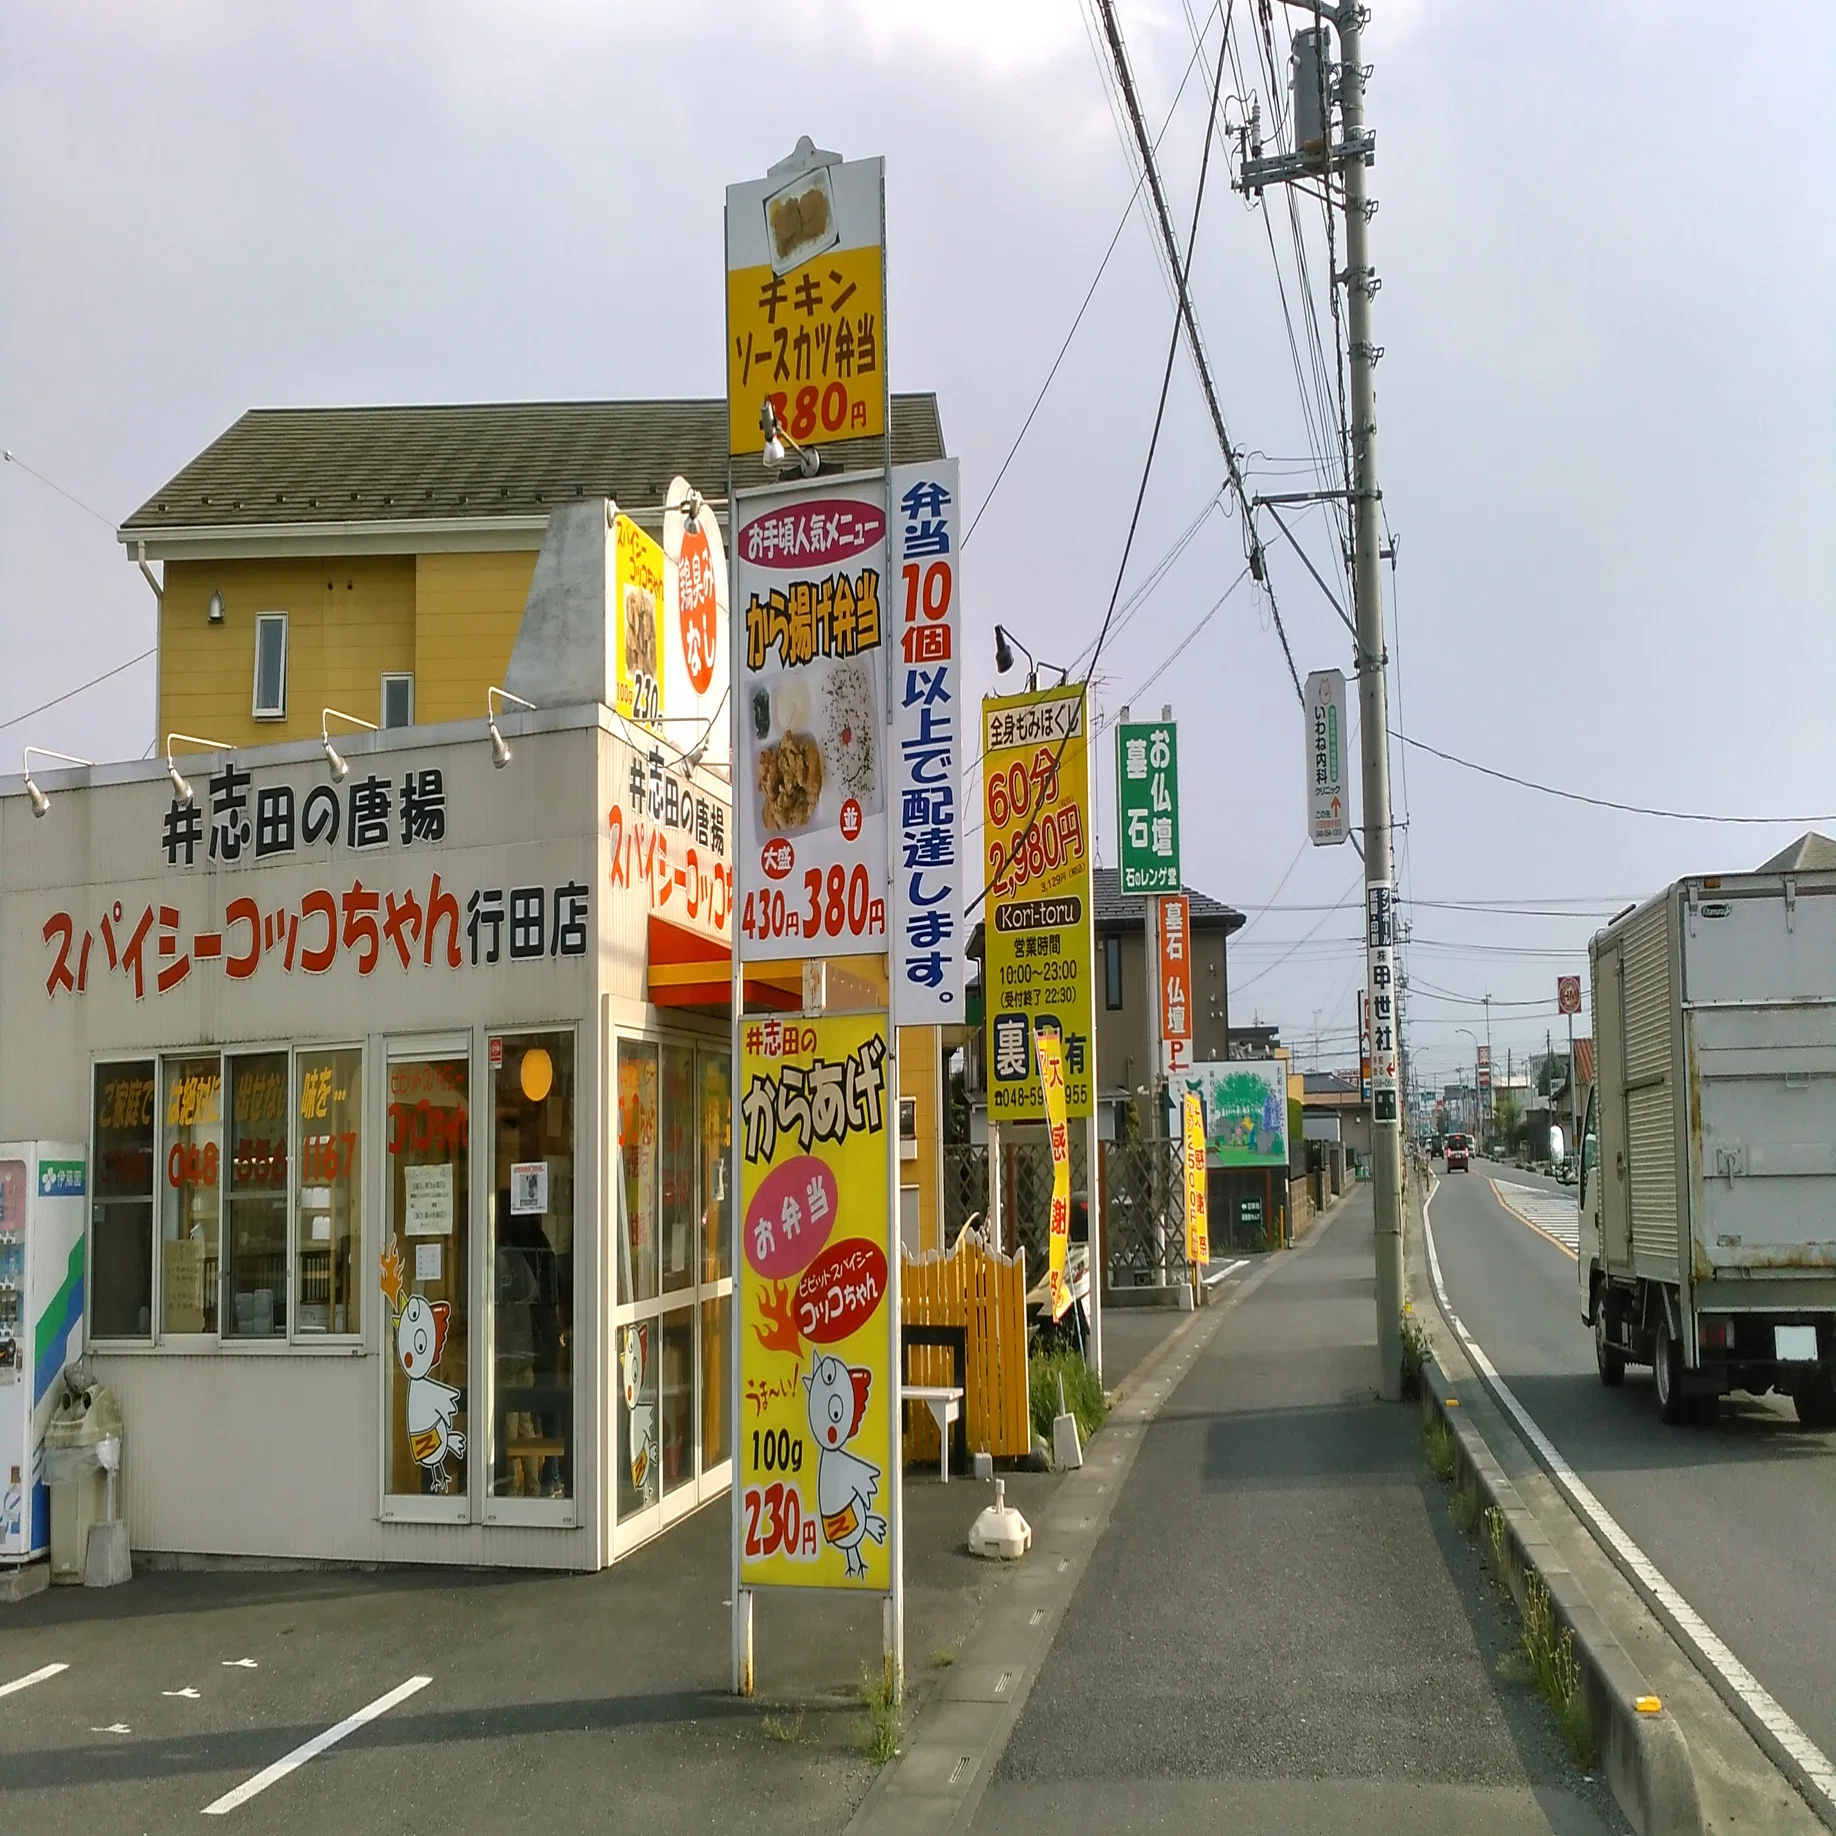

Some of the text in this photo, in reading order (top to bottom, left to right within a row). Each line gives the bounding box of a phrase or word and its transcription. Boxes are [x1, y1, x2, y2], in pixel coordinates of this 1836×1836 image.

[759, 269, 857, 324] チキン
[736, 313, 876, 387] ソースカツ弁当
[748, 513, 880, 560] お手頃人気メニュー
[687, 613, 715, 677] なし
[746, 567, 882, 673] から揚げ弁当
[616, 682, 633, 706] 100g
[990, 703, 1079, 746] 全身もみほぐし
[900, 481, 955, 1004] 弁当10個以上で配達します。
[1314, 705, 1328, 785] いわね内科
[162, 763, 447, 867] 井志田の唐揚
[629, 746, 725, 857] 井志田の唐揚
[843, 805, 858, 833] 並
[988, 746, 1059, 829] 60分
[1126, 738, 1149, 848] 墓石
[1150, 729, 1173, 857] お仏壇
[1315, 785, 1341, 796] クリニック
[1315, 810, 1331, 819] この先
[764, 845, 791, 872] 大盛
[989, 804, 1085, 897] 2,980円
[1125, 868, 1177, 888] 石のレンゲ堂
[742, 887, 799, 941] 430円
[803, 863, 885, 939] 380円
[1001, 904, 1075, 929] Kori-toru
[1381, 888, 1391, 945] ダンボール
[1014, 934, 1061, 959] 営業時間
[1165, 902, 1186, 1033] 墓石 仏壇
[746, 1018, 817, 1058] 井志田の
[1373, 966, 1393, 1052] 甲世社
[1170, 1041, 1184, 1060] P
[742, 1033, 887, 1164] からあげ
[168, 1142, 220, 1188] 048
[302, 1131, 358, 1183] 1167
[754, 1175, 829, 1260] お弁当
[800, 1271, 879, 1334] コッコちゃん
[752, 1428, 803, 1472] 100g
[745, 1483, 817, 1556] 230円
